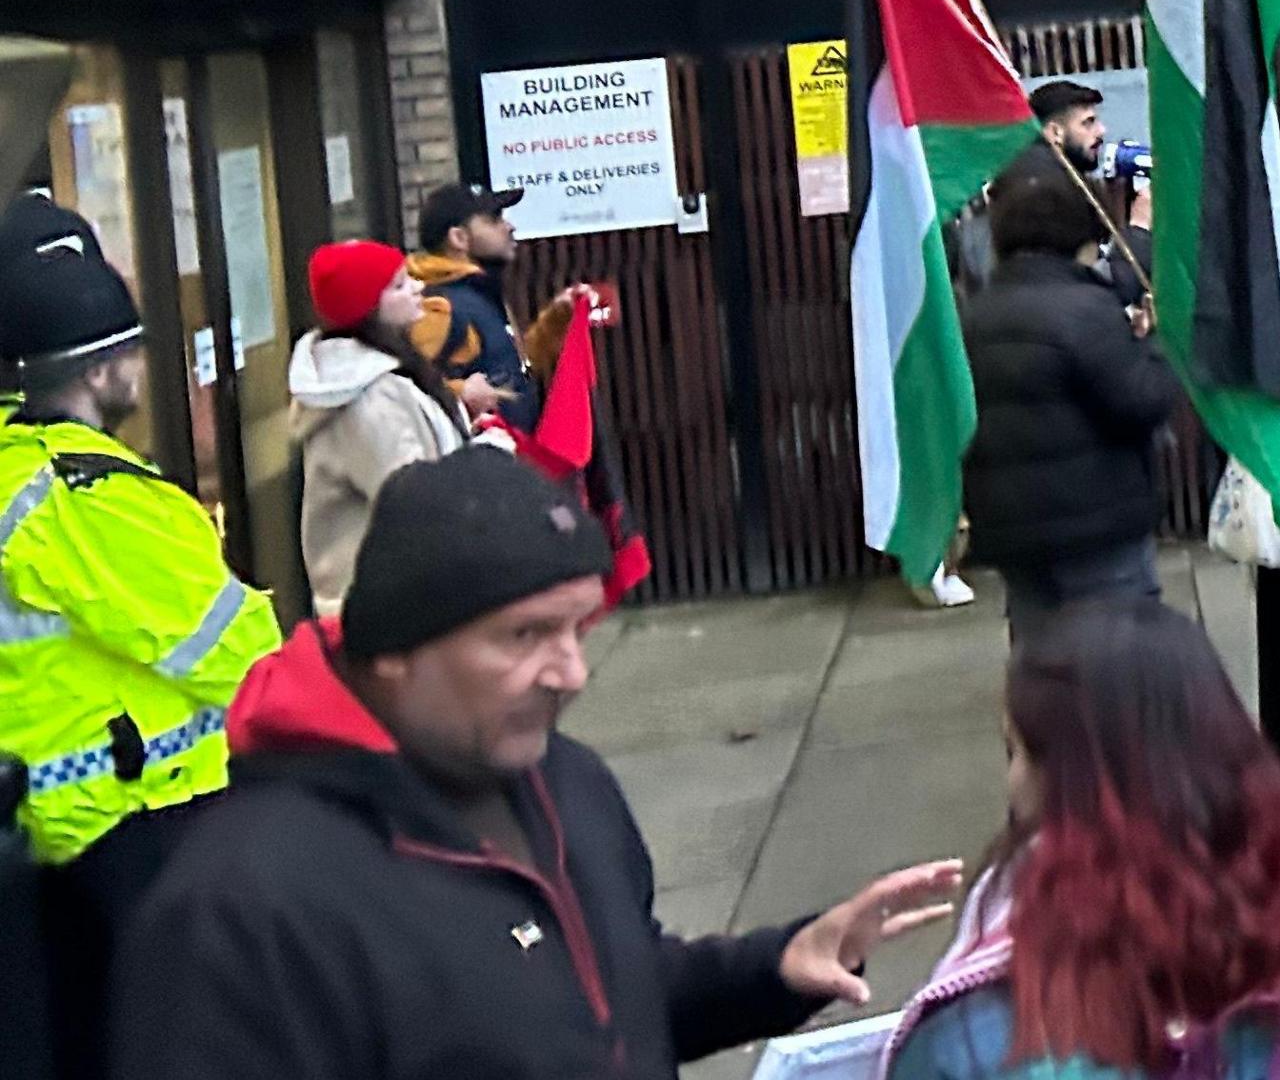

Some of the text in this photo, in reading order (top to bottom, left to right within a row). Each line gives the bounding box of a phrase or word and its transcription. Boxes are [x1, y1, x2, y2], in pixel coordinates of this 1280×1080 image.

[524, 72, 626, 95] BUILDING
[799, 79, 845, 93] WARN
[500, 91, 654, 119] MANAGEMENT
[503, 129, 658, 155] NO PUBLIC ACCESS
[506, 162, 660, 188] STAFF & DELIVERIES
[565, 183, 605, 197] ONLY
